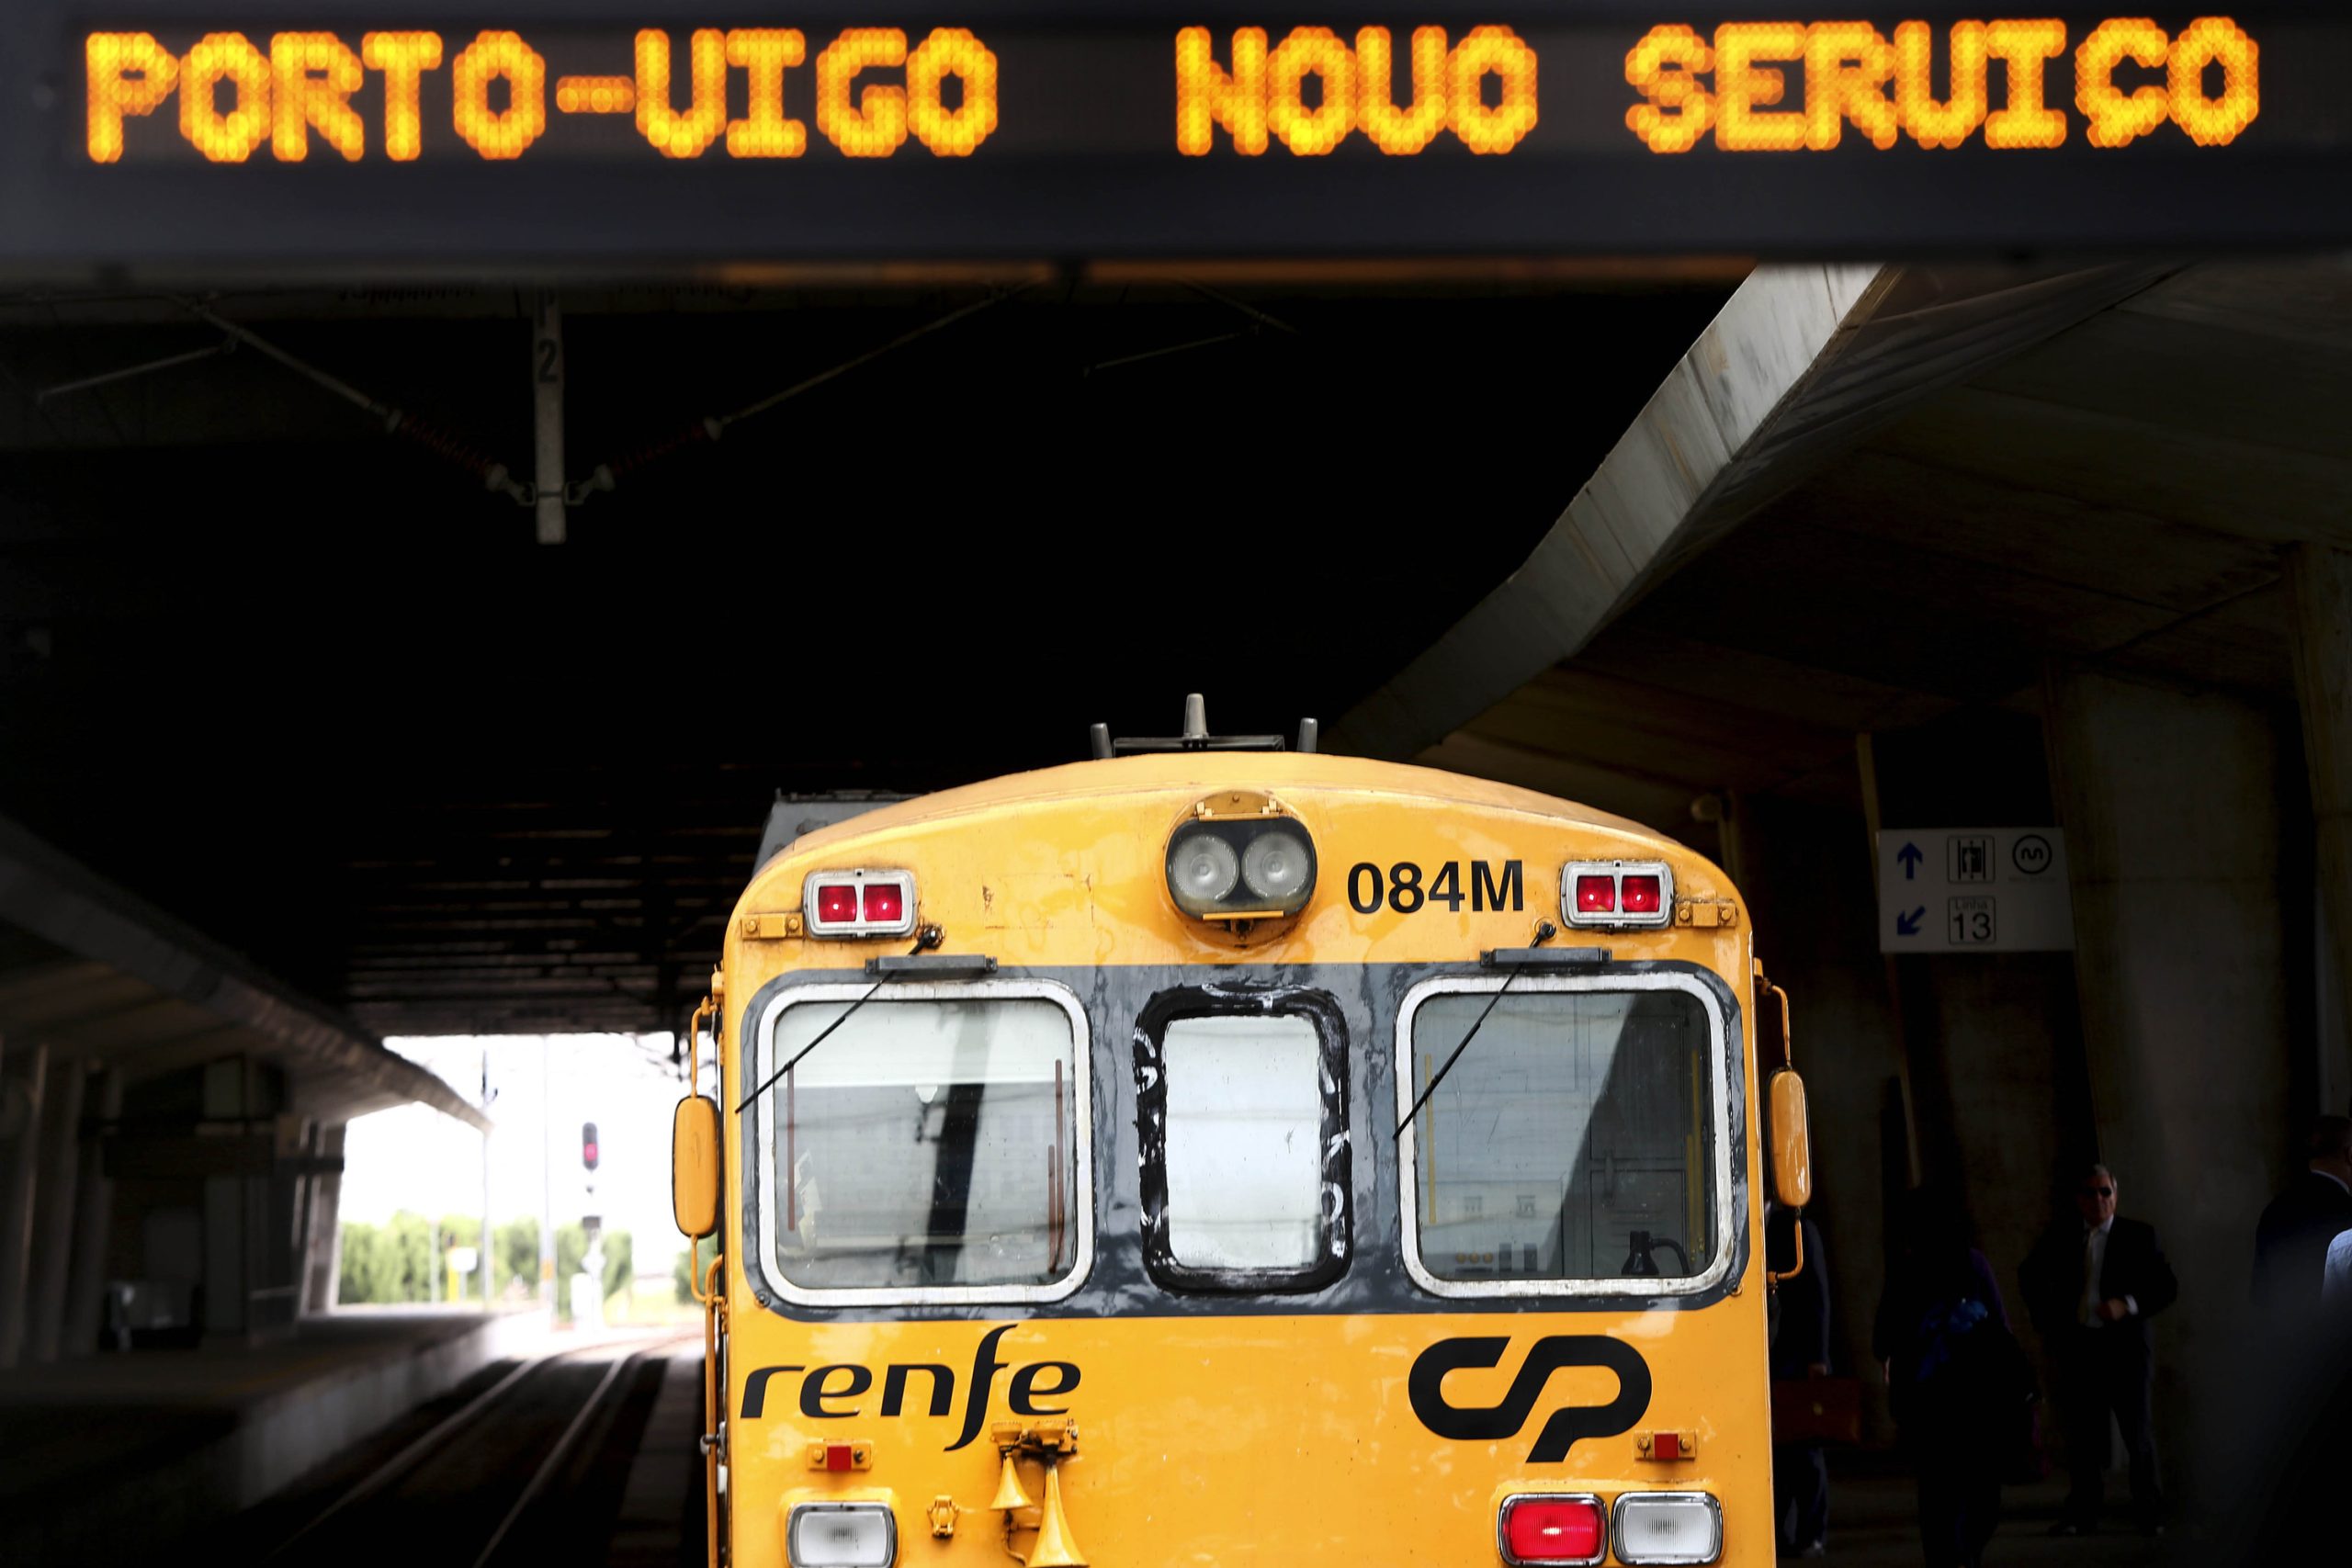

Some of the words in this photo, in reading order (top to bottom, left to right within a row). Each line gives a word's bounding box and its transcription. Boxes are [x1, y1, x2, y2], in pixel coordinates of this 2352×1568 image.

[537, 338, 559, 383] 2
[1348, 859, 1524, 915] 084M
[1952, 912, 1992, 941] 13
[741, 1324, 1081, 1452] renfe
